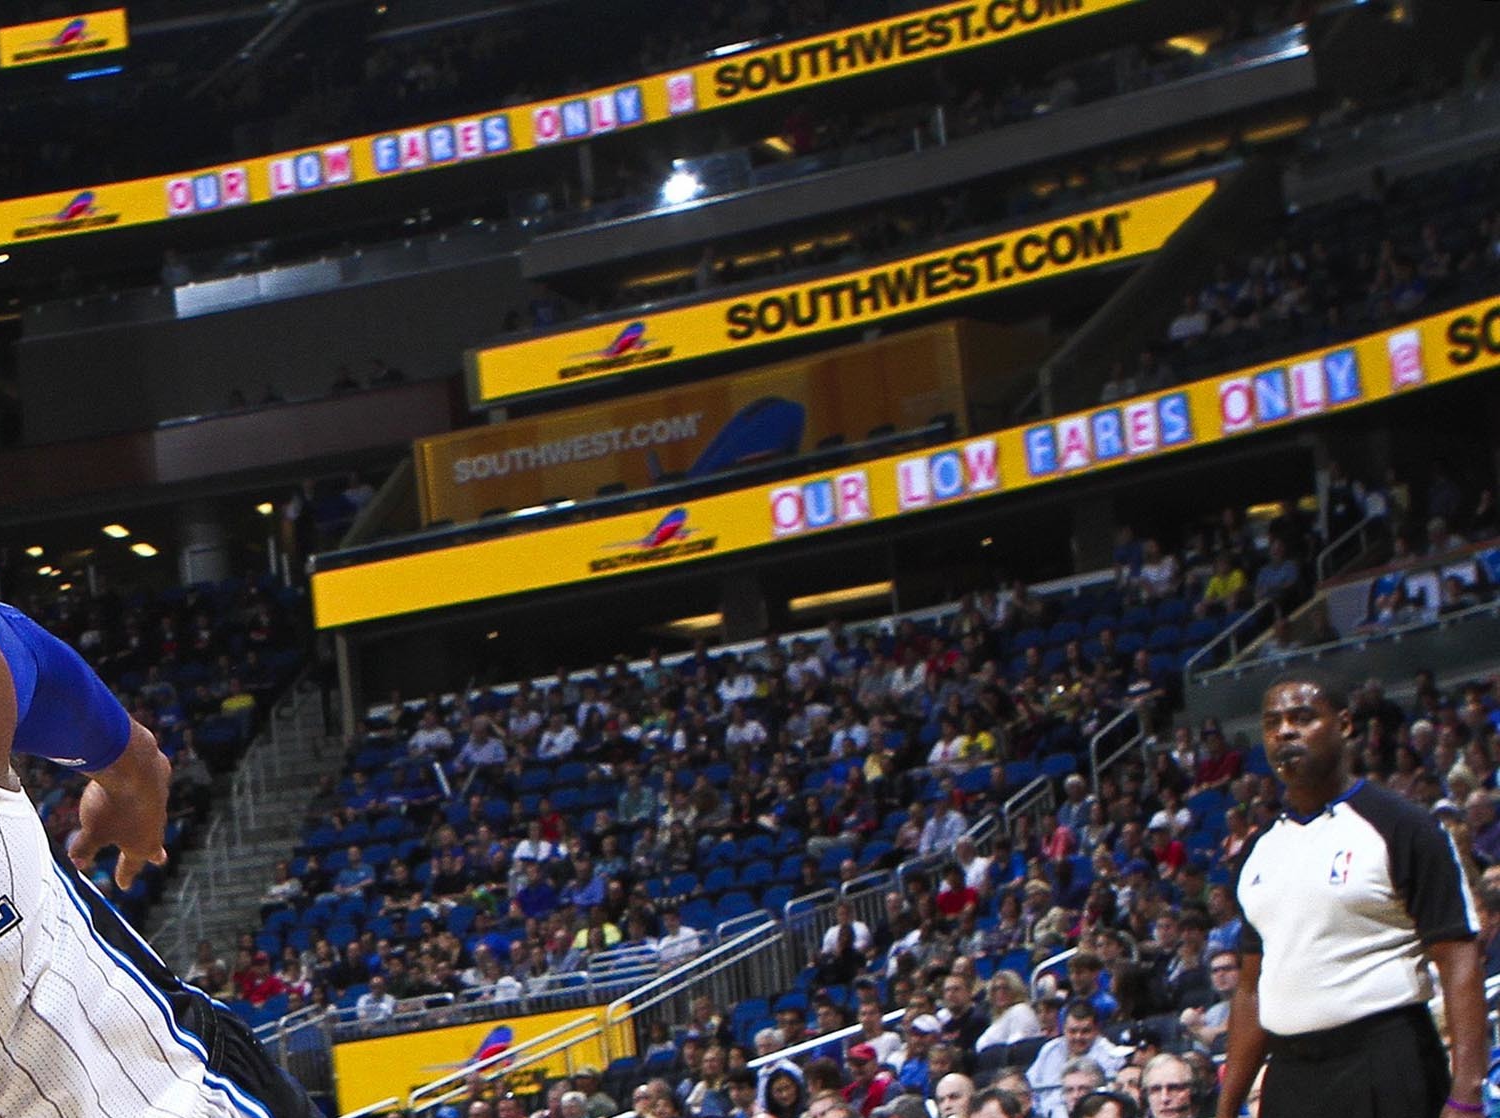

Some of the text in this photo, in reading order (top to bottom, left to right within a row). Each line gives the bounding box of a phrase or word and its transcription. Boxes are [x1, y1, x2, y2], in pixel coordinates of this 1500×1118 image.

[168, 171, 246, 213] OUR
[375, 116, 508, 171] FARES
[536, 88, 640, 141] ONLY
[726, 211, 1126, 340] SOUTHWEST.COM
[453, 415, 701, 485] SOUTHWEST.COM
[771, 475, 869, 531] OUR
[898, 441, 999, 507] LOW
[1026, 394, 1192, 477] FARES
[1220, 348, 1360, 431] ONLY
